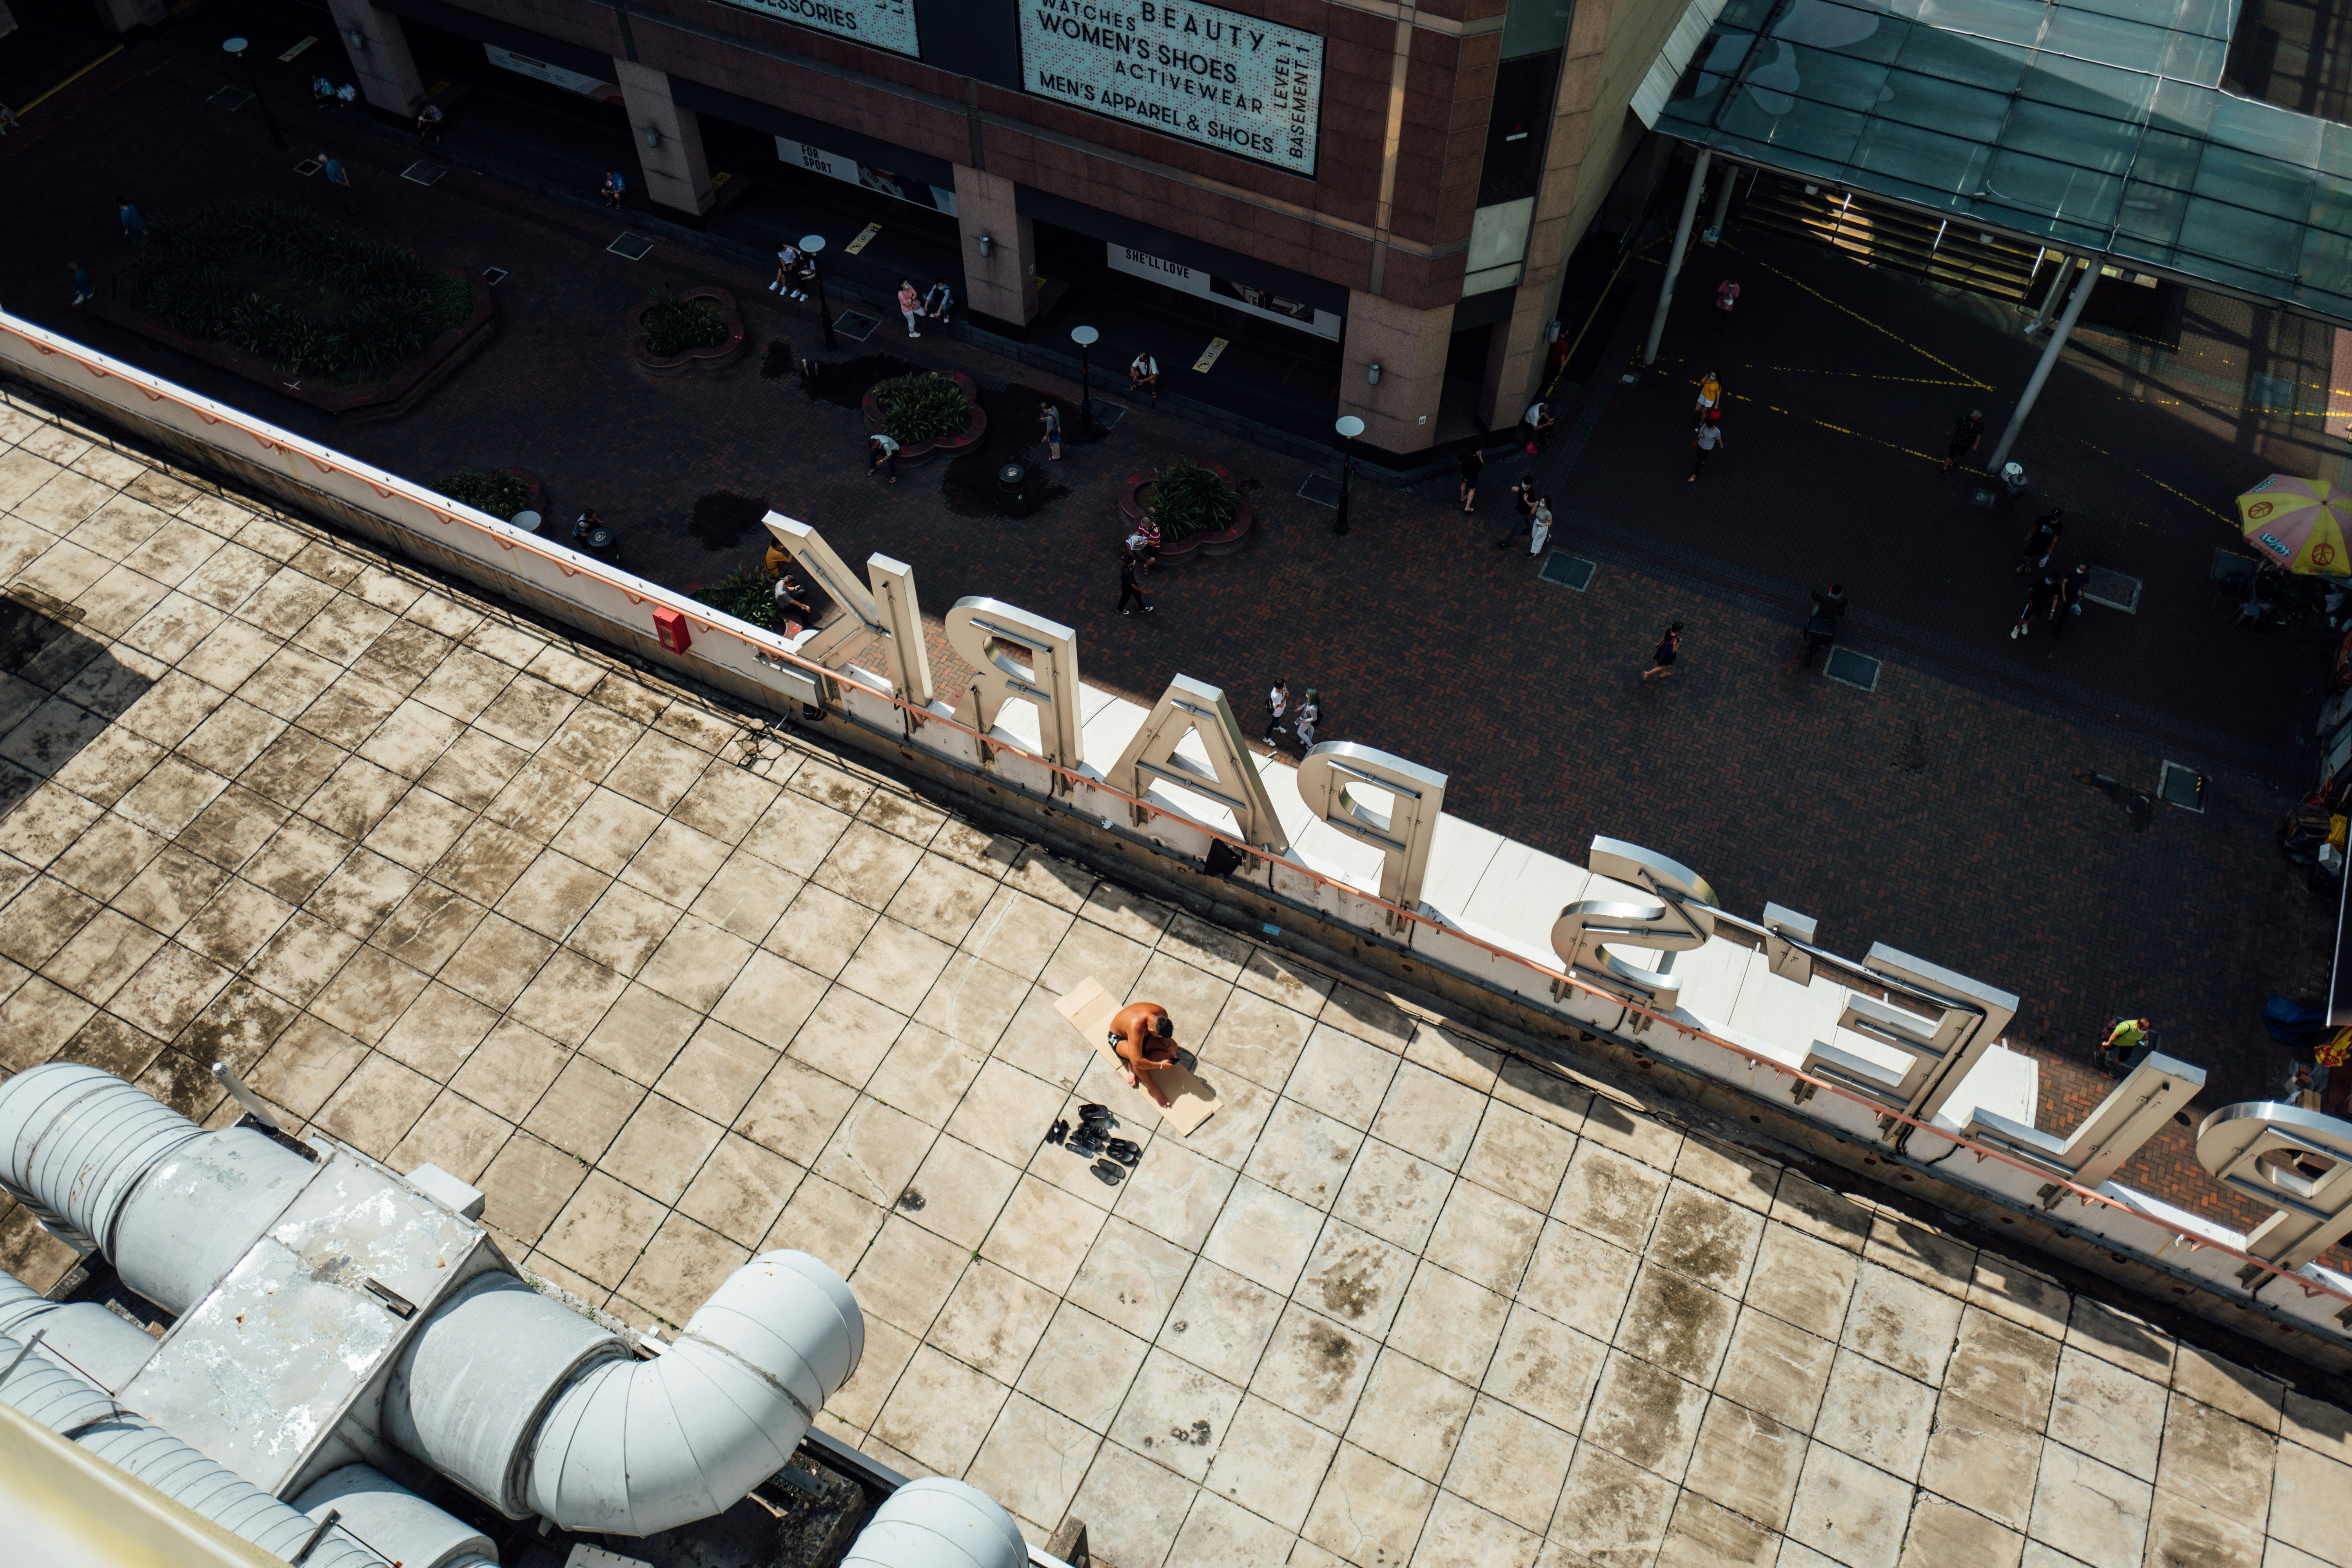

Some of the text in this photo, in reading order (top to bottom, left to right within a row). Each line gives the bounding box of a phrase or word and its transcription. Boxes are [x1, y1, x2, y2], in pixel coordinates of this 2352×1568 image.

[1043, 0, 1135, 31] WATCHES
[1142, 1, 1265, 51] BEAUTY
[1038, 10, 1236, 83] WOMEN'S SHOES
[1115, 60, 1262, 114] ACTIVEWEAR
[1274, 56, 1290, 109] LEVEL
[1040, 71, 1273, 153] MEN'S APPAREL & SHOES
[1290, 60, 1308, 159] BASEMENT
[801, 145, 818, 159] FOR
[803, 156, 832, 173] SPORT
[1126, 249, 1189, 278] SHE'LL LOVE
